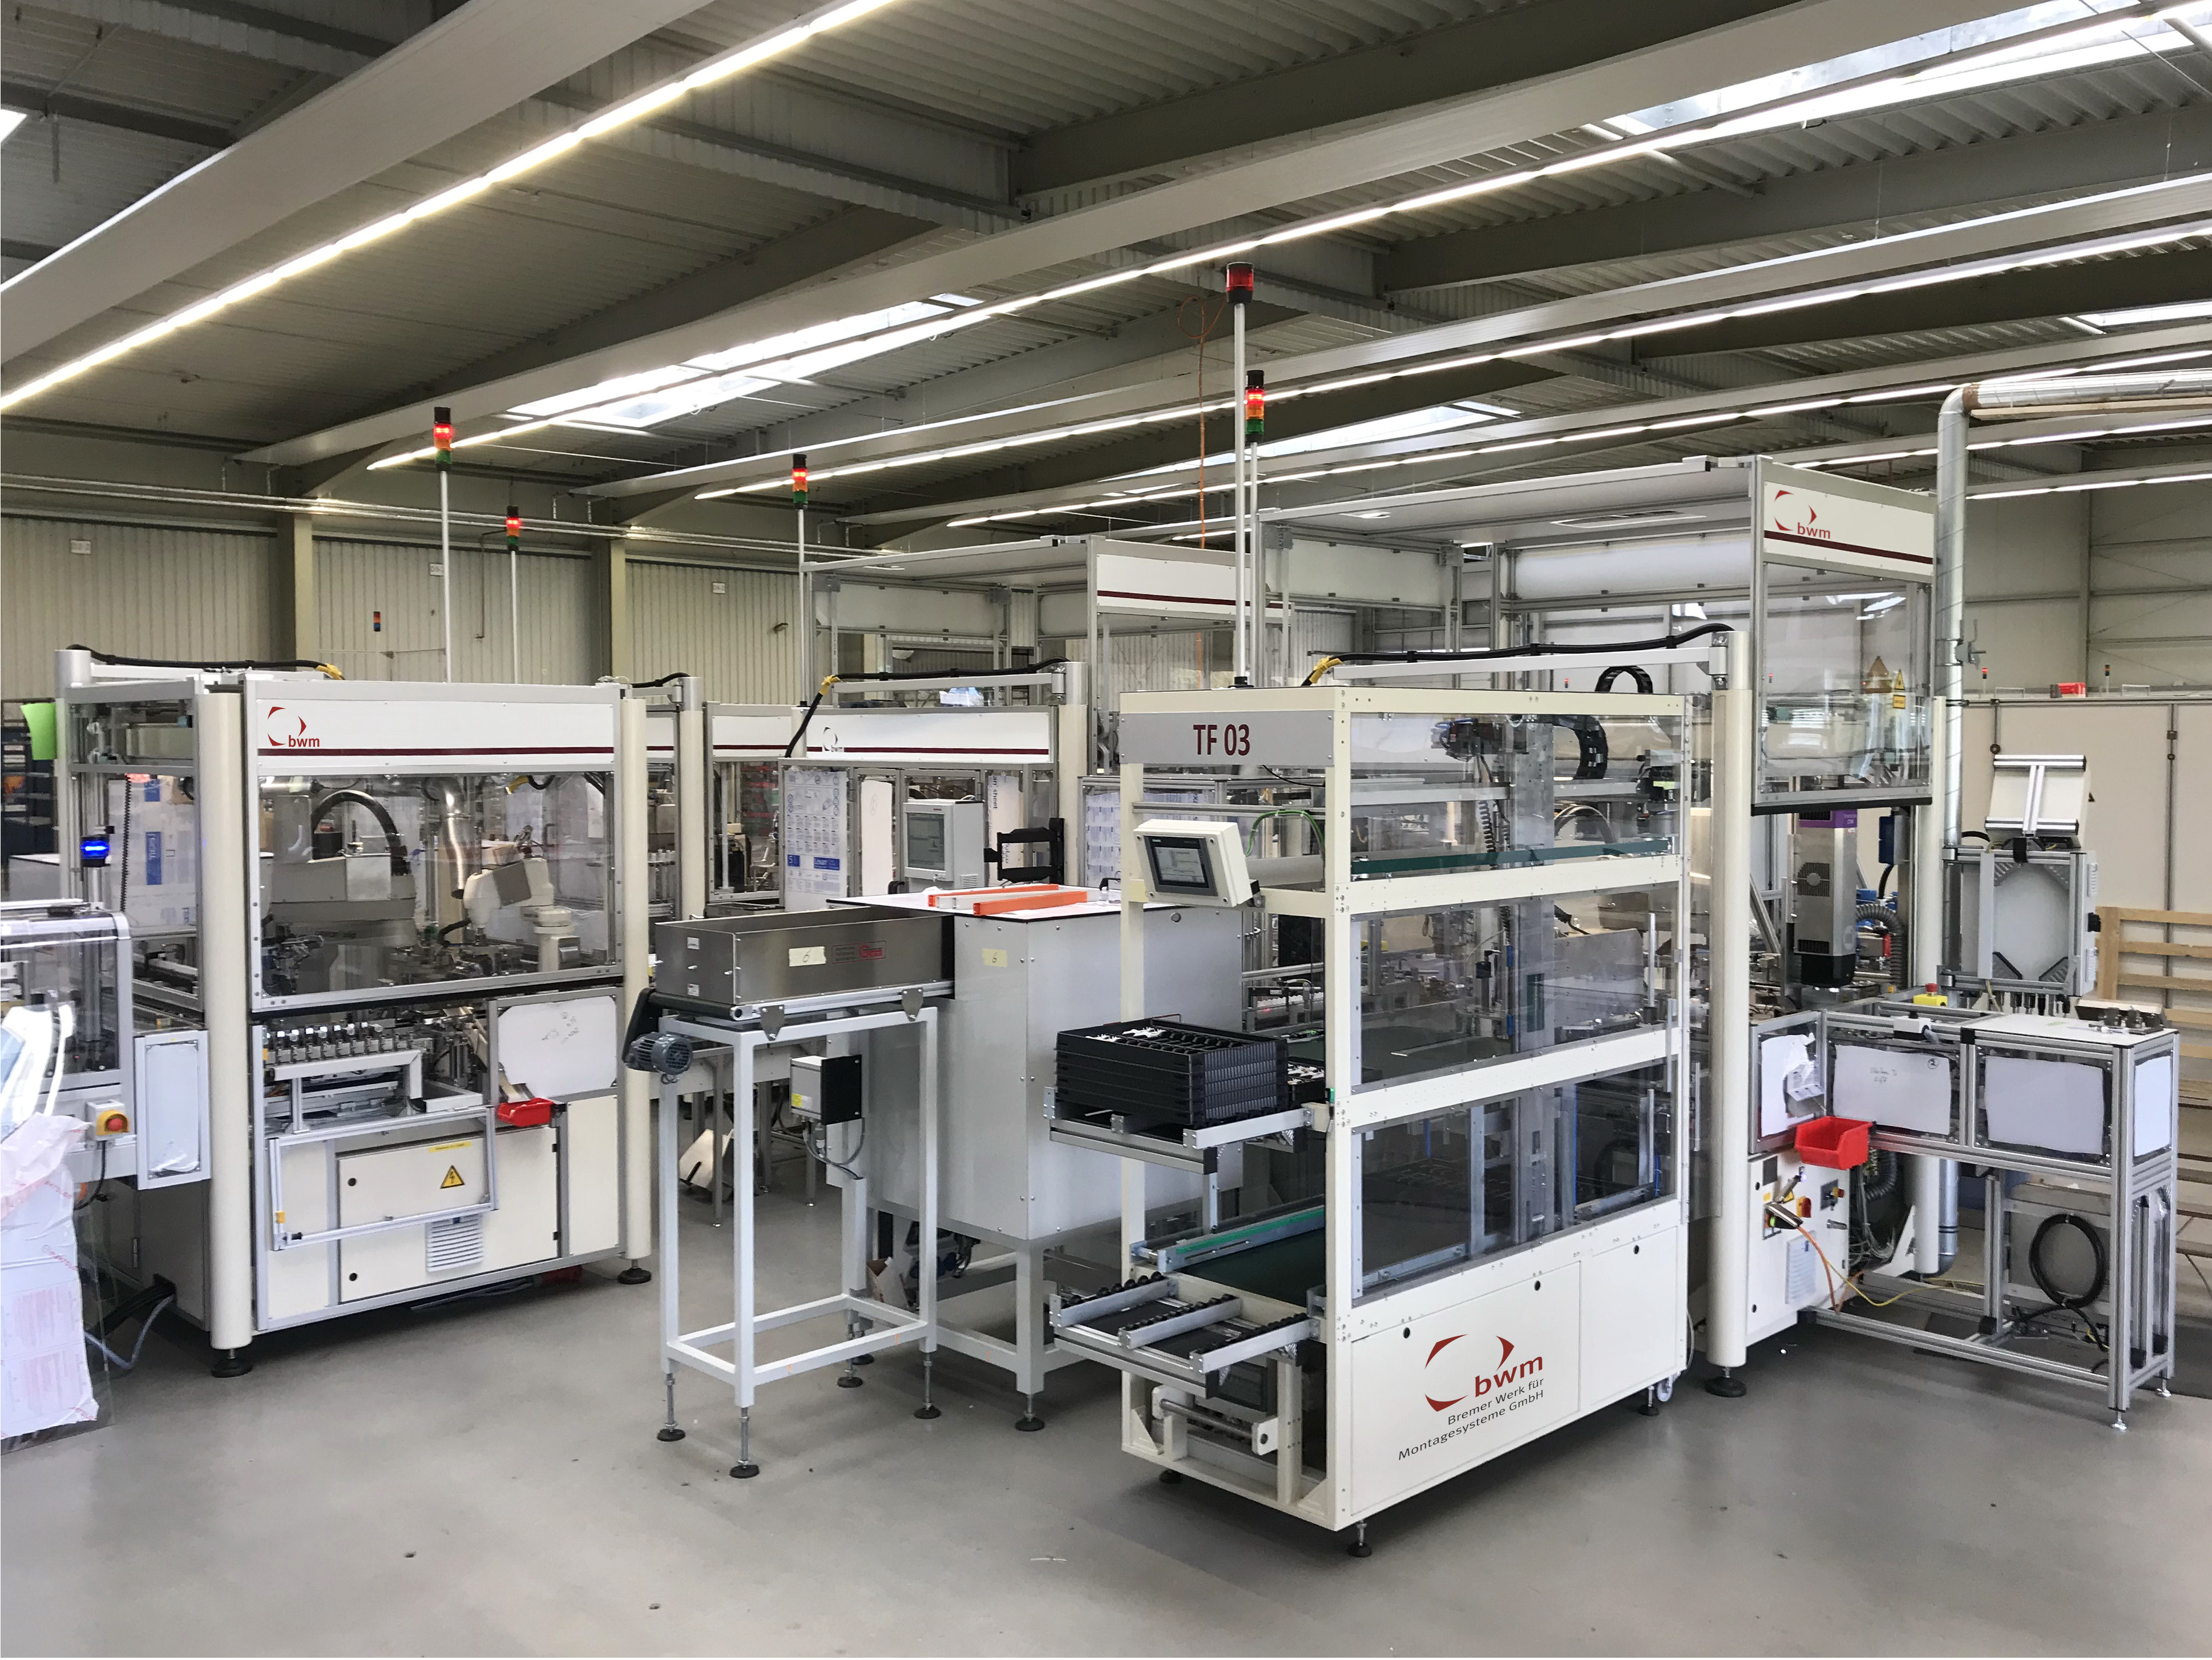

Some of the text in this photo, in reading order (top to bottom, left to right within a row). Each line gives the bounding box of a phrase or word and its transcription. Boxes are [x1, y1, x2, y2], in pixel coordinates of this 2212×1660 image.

[1798, 522, 1830, 539] bwm
[288, 735, 320, 747] bwm
[1193, 724, 1250, 756] TF 03
[802, 949, 812, 963] 6
[991, 952, 998, 963] 6
[1475, 1356, 1543, 1397] bwm
[1448, 1378, 1544, 1425] Bremer Werk für
[1398, 1389, 1544, 1461] Montagesysteme GmbH
